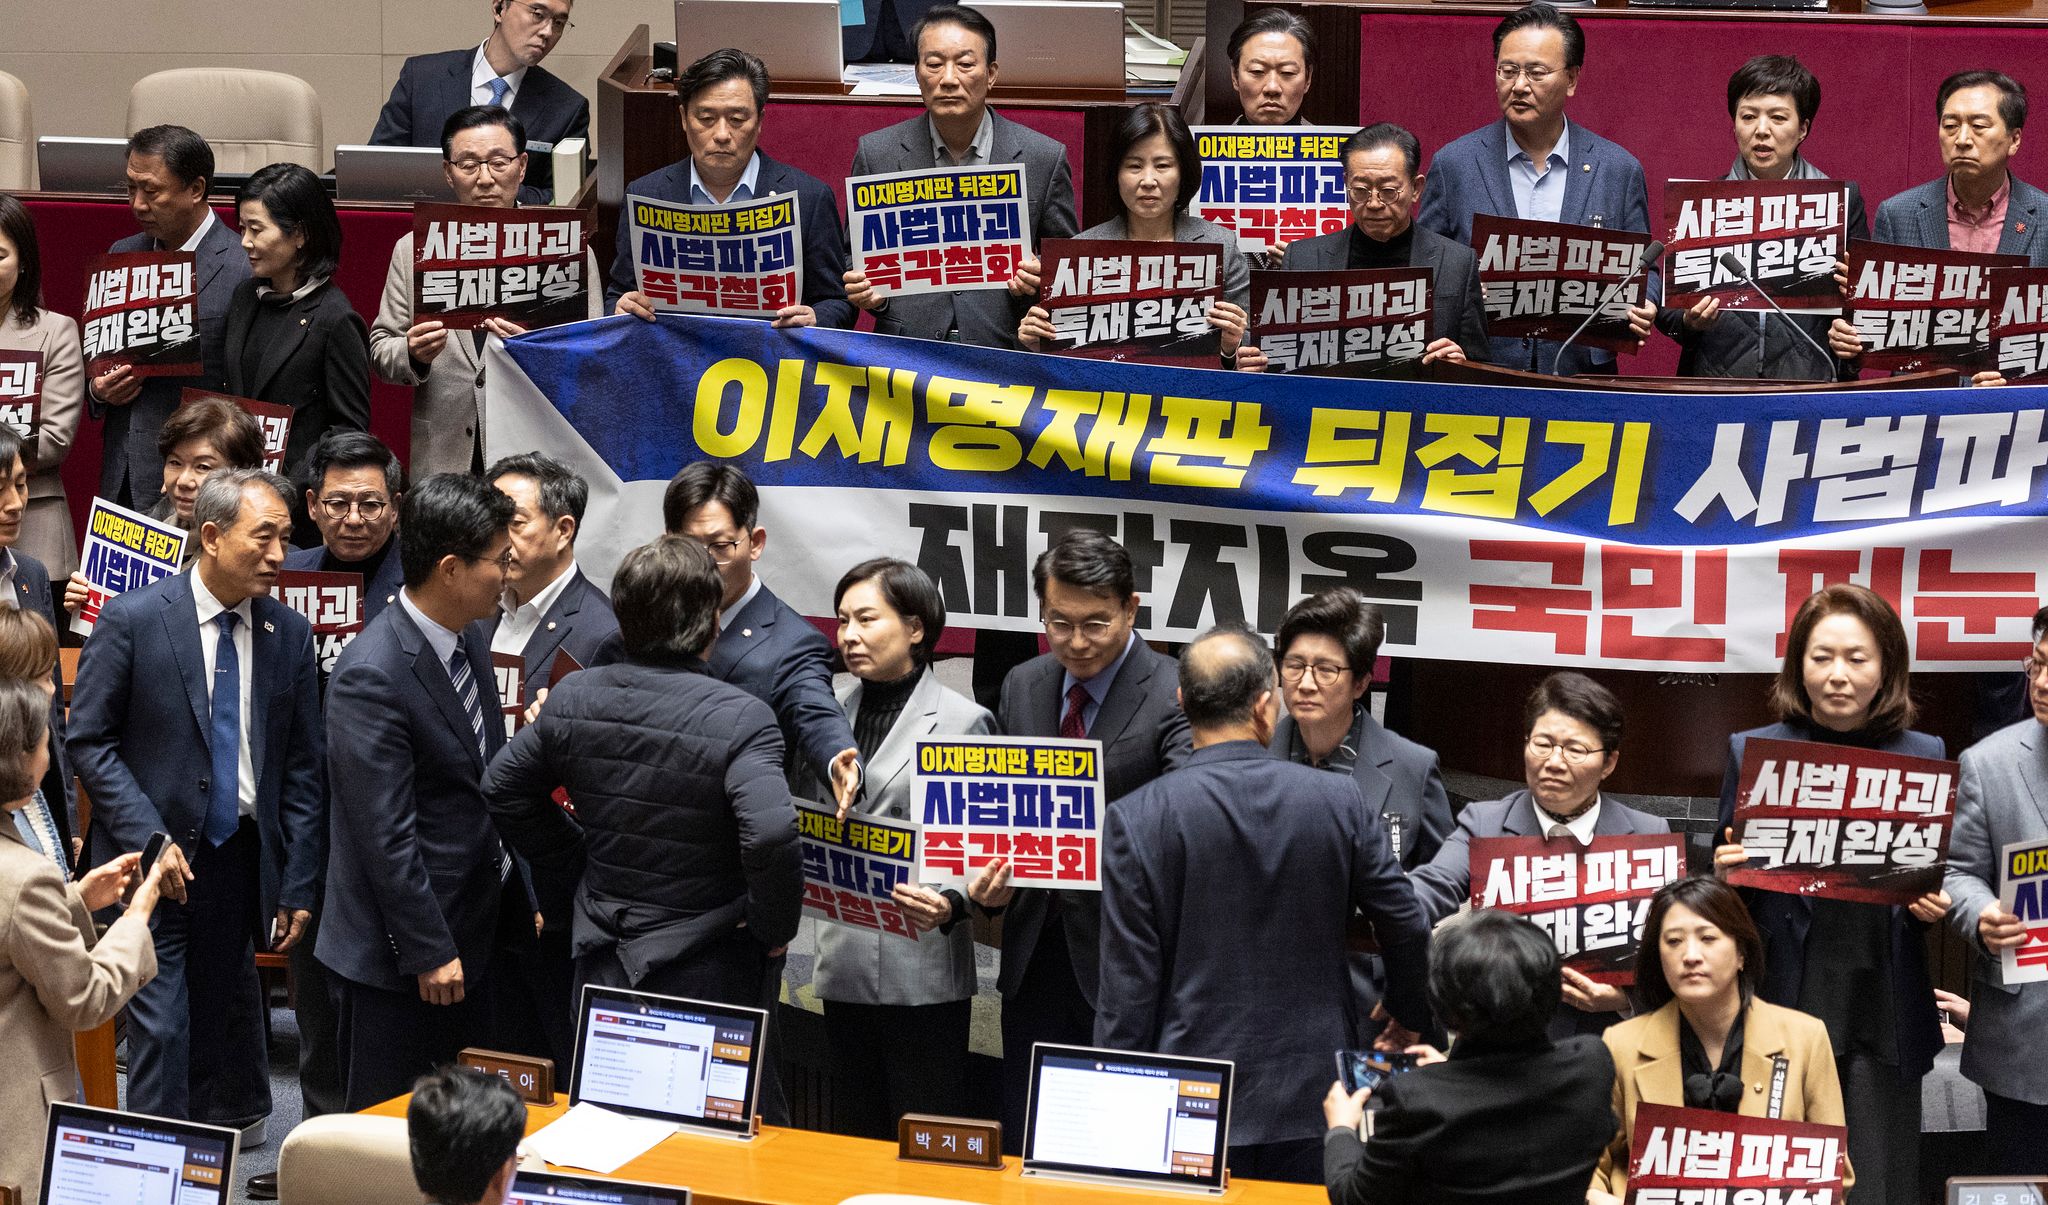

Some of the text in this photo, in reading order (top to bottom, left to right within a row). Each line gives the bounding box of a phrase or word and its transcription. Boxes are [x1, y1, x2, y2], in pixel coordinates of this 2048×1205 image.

[1199, 136, 1295, 159] 이재명재판
[856, 173, 1018, 208] 이재명재판 뒤집기
[637, 201, 792, 234] 이재명재판 뒤집기
[862, 203, 1022, 252] 사법파괴
[1675, 192, 1840, 241] 사법 파괴
[423, 220, 582, 261] 사법 파괴
[641, 231, 795, 272] 사법파괴
[1479, 234, 1646, 276] 사법 파괴
[1673, 234, 1838, 291] 독재 완성
[86, 262, 194, 312] 사법 파괴
[422, 261, 581, 311] 독재 완성
[642, 270, 796, 310] 즉각철회
[863, 244, 1024, 290] 즉각철회
[1051, 253, 1217, 298] 사법 파괴
[1855, 260, 1937, 301] 사법
[1051, 297, 1214, 346] 독재 완성
[1260, 279, 1428, 325] 사법 파괴
[1483, 280, 1640, 319] 독재 완성
[2000, 284, 2048, 326] 사
[83, 304, 193, 359] 독재 완성
[1261, 320, 1427, 372] 독재 완성
[1853, 309, 1930, 350] 독재
[1998, 333, 2048, 377] 독
[255, 415, 288, 452] 괴
[692, 358, 2048, 527] 이재명재판 뒤집기 사법파
[93, 510, 181, 563] 이재명재판 뒤집기
[1469, 538, 1728, 662] 국민
[1776, 546, 2040, 661] 피눈
[921, 746, 1094, 778] 이재명재판 뒤집기
[923, 781, 1096, 830] 사법파괴
[1749, 760, 1952, 817] 사법 파괴
[849, 824, 912, 858] 뒤집기
[924, 832, 1097, 881] 즉각철회
[1741, 818, 1943, 869] 독재 완성
[1483, 846, 1678, 907] 사법 파괴
[1522, 907, 1579, 957] 재
[916, 1132, 982, 1155] 박지혜
[1638, 1126, 1841, 1183] 사법 파괴
